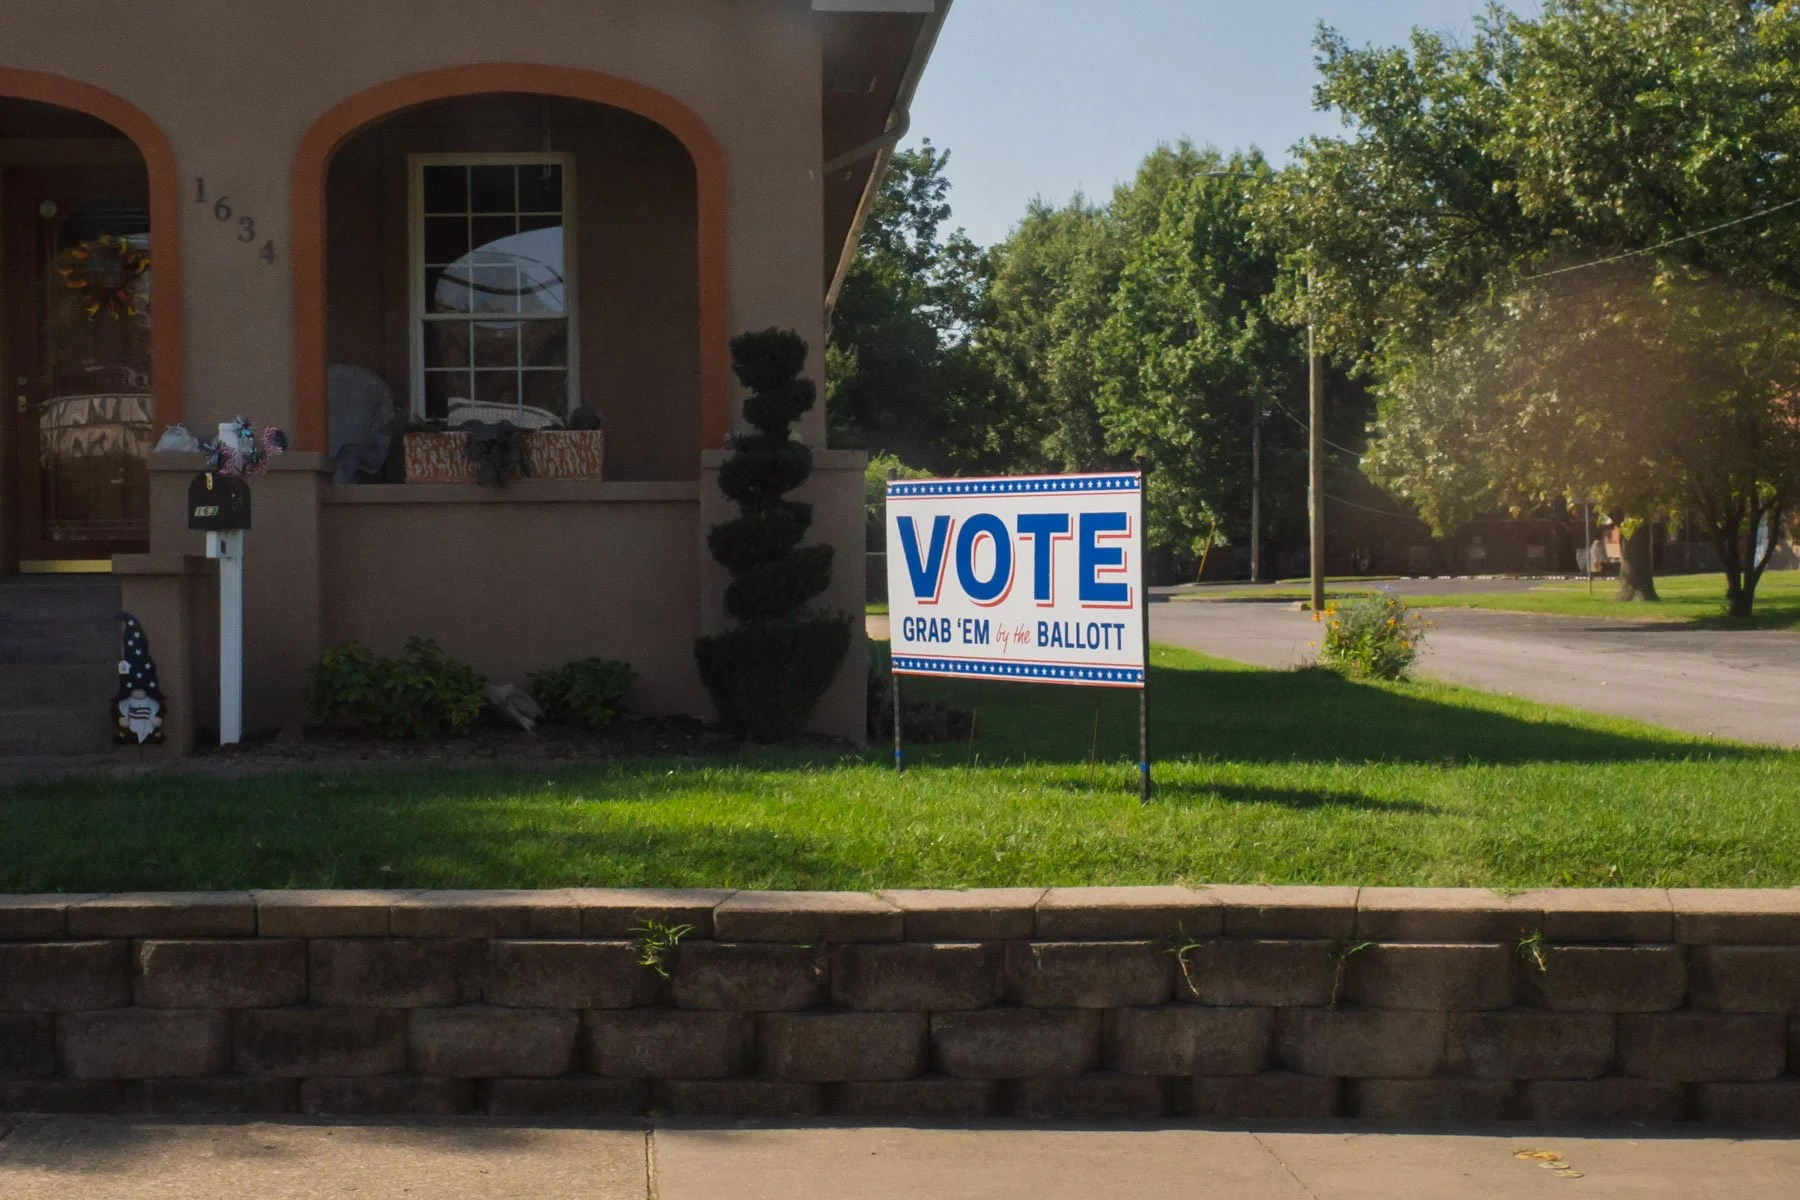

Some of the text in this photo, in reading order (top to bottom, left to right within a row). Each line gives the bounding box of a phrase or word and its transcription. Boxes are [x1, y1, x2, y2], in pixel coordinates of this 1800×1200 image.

[194, 176, 277, 265] 1634
[896, 512, 1133, 610] VOTE
[903, 616, 952, 643] GRAB
[996, 622, 1009, 653] by
[1013, 623, 1032, 645] the
[1037, 621, 1126, 650] BALLOTT
